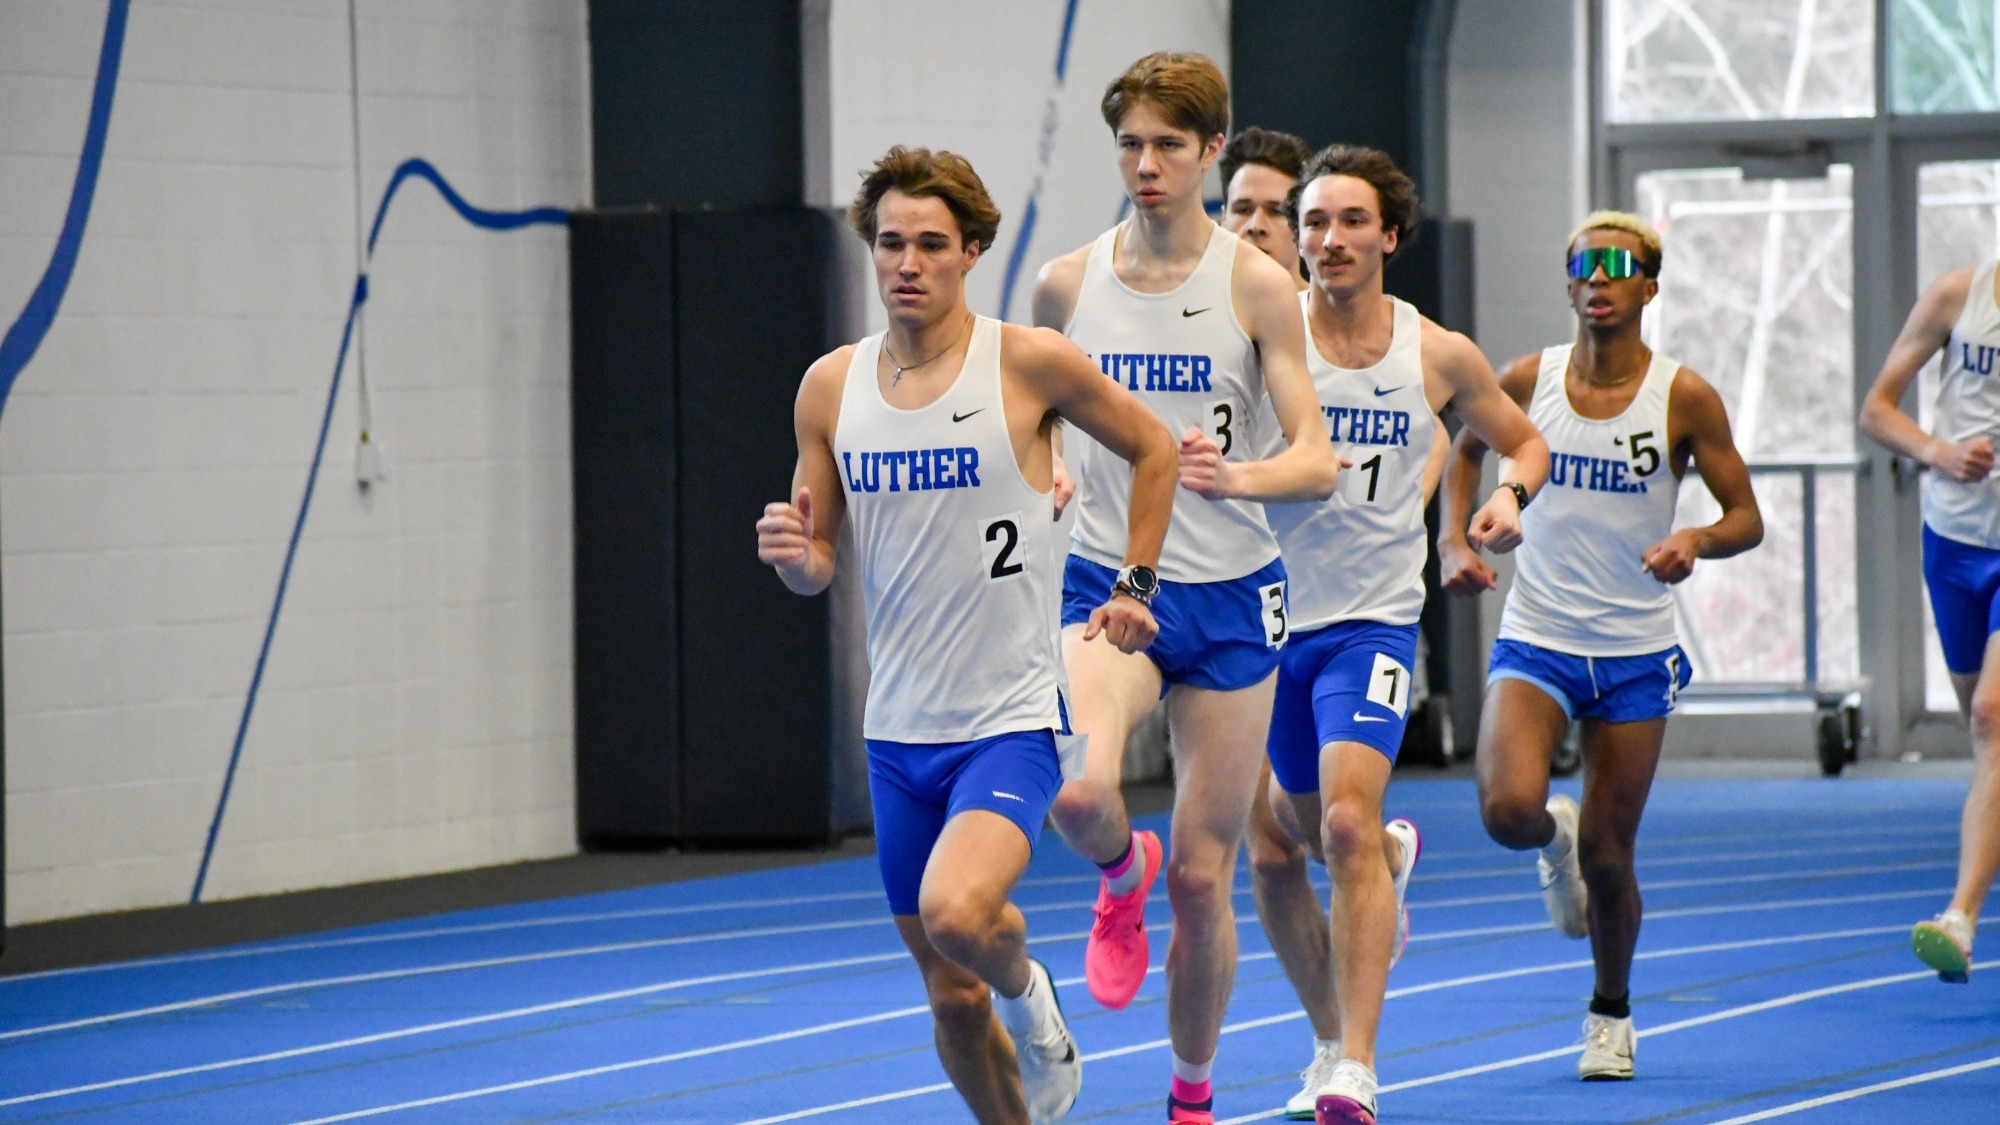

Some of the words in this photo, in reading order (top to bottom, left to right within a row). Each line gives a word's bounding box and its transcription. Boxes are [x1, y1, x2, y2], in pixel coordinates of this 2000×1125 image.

[1088, 354, 1212, 392] UTHER
[1963, 343, 2000, 376] LU
[1213, 403, 1233, 457] 3
[1320, 406, 1410, 447] THER
[843, 447, 981, 493] LUTHER
[1550, 452, 1647, 493] UTHE
[1629, 431, 1660, 478] 5
[1360, 454, 1382, 502] 1
[985, 519, 1023, 579] 2
[1269, 586, 1286, 642] 3
[1383, 667, 1401, 706] 1
